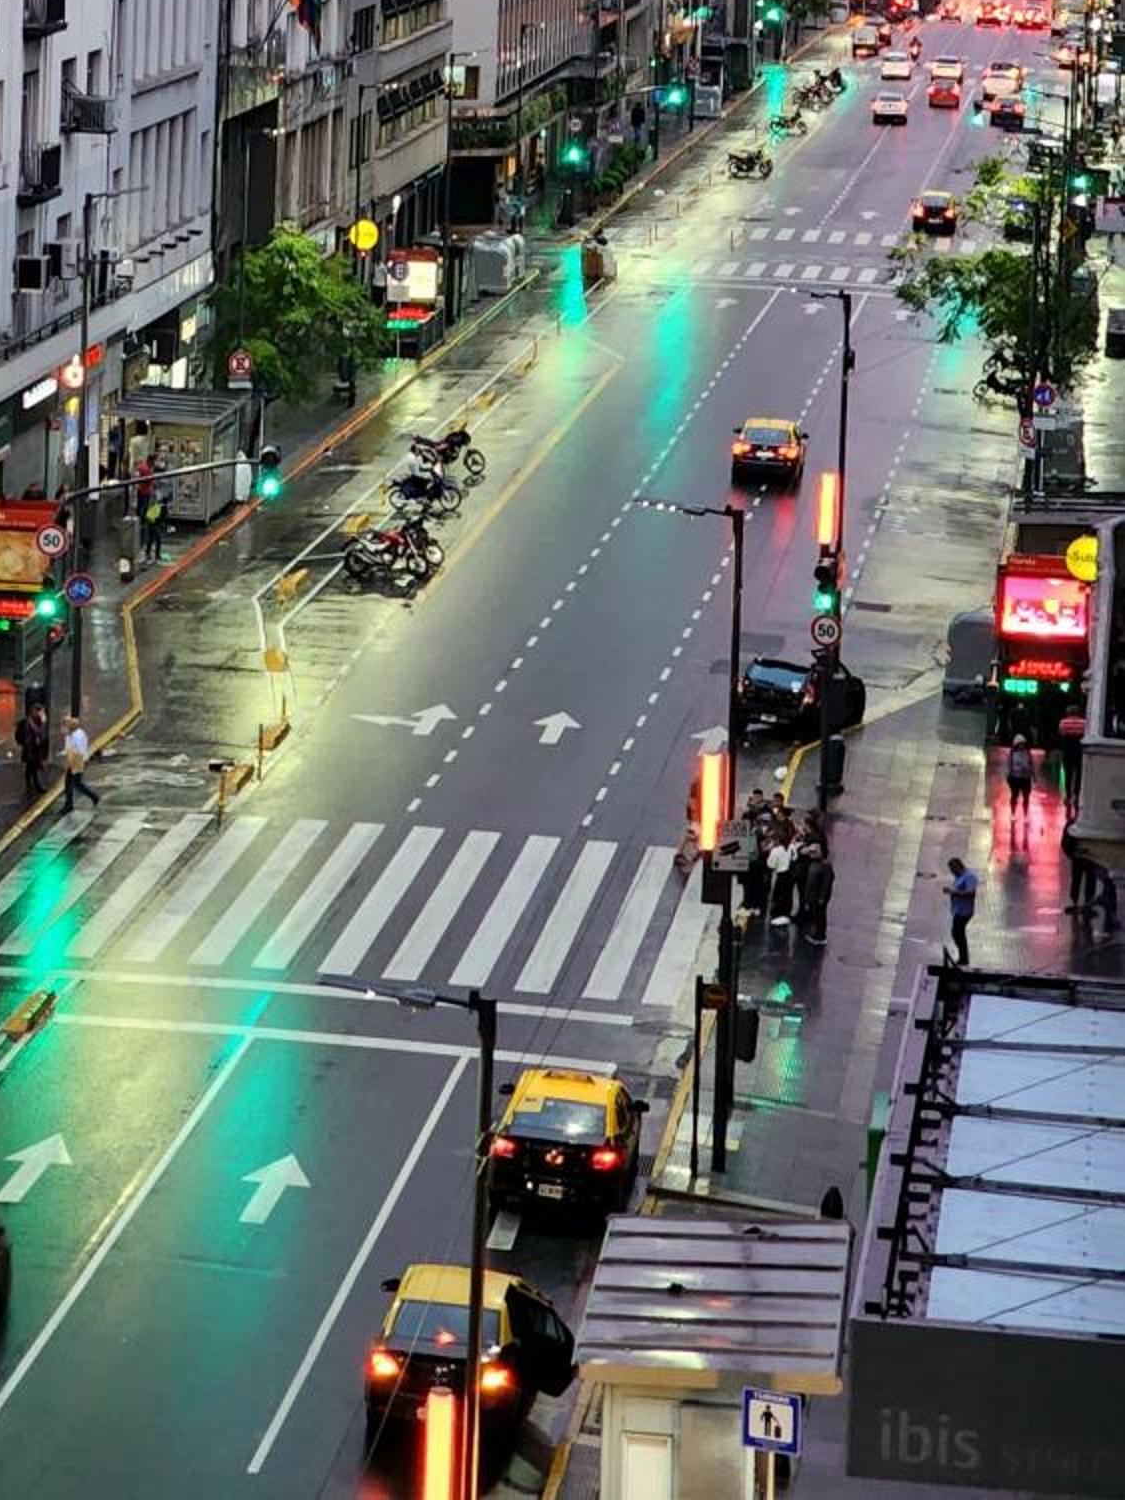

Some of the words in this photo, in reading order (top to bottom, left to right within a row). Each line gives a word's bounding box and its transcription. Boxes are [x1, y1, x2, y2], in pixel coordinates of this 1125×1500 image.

[42, 532, 60, 548] 50
[818, 623, 835, 638] 50
[880, 1407, 980, 1469] ibis
